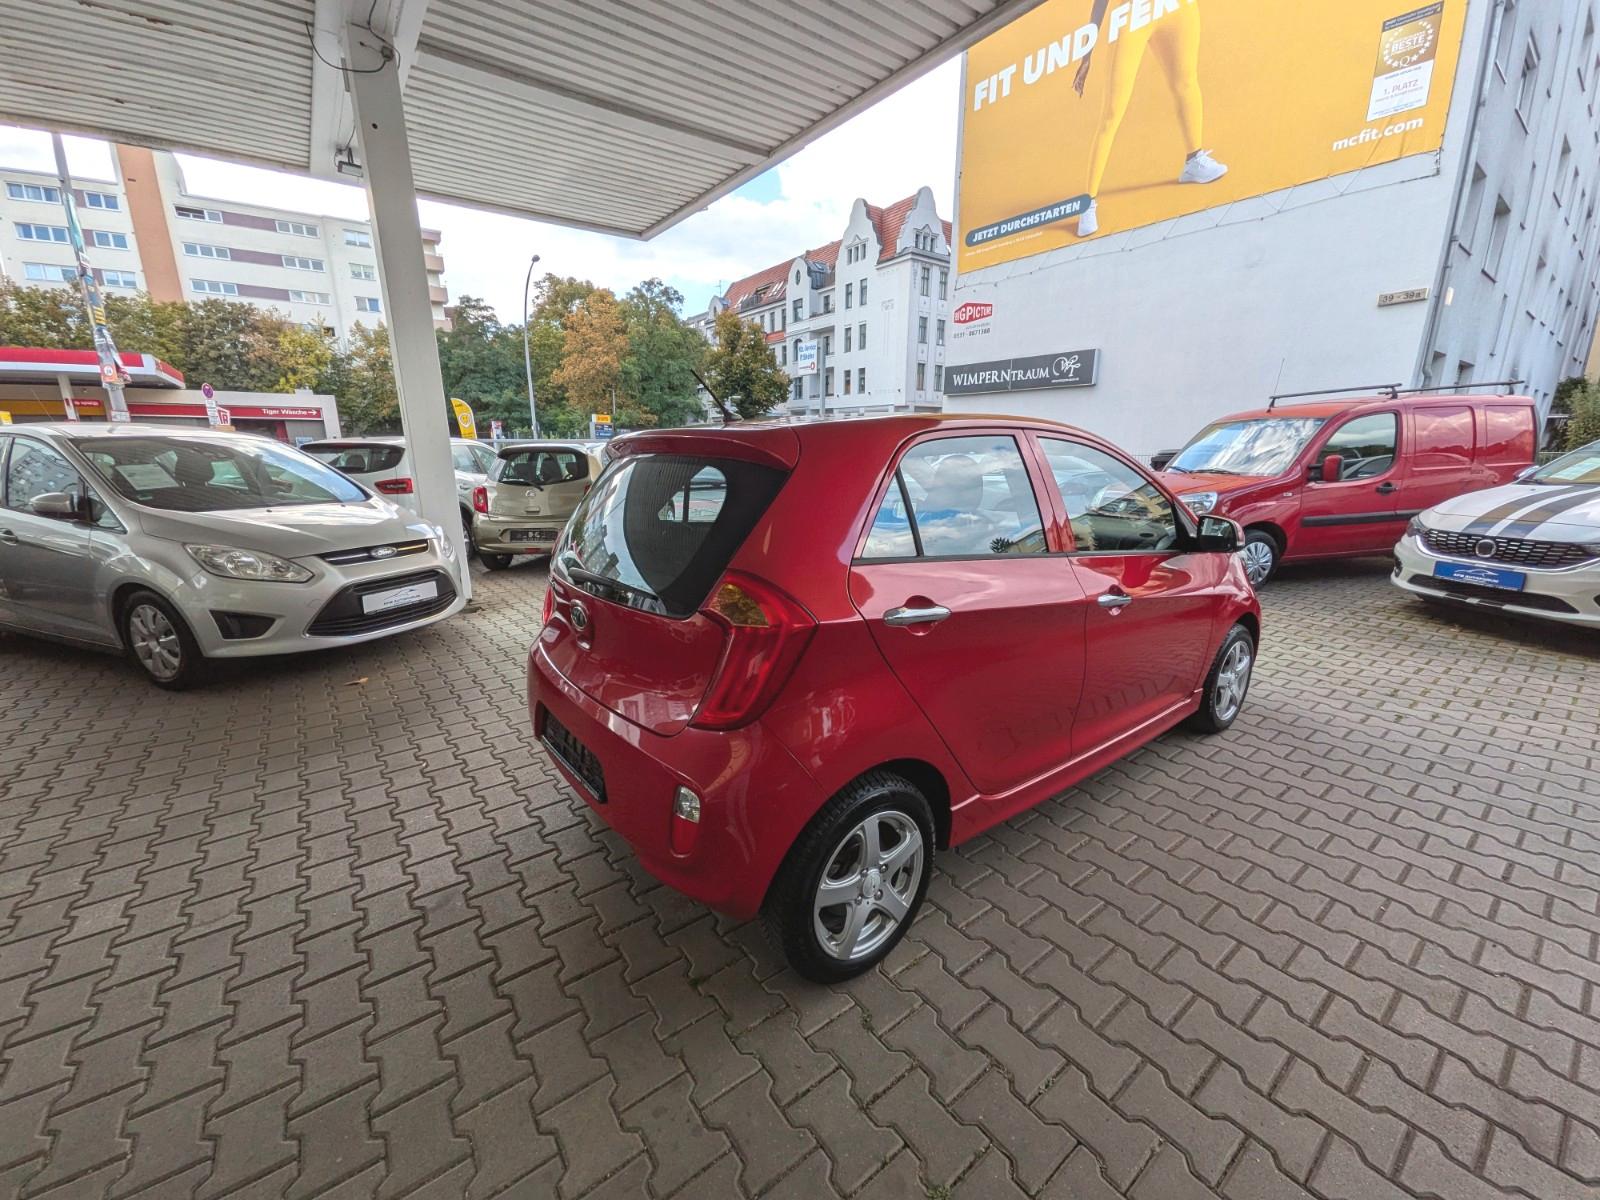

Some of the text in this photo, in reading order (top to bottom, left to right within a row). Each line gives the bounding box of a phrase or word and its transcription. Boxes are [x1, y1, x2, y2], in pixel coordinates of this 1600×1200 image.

[973, 0, 1194, 112] FIT UND FER
[1392, 79, 1419, 93] PLATZ
[1332, 118, 1424, 152] mcfit.com
[972, 200, 1081, 242] JETZT DURCHSTARTEN
[952, 366, 1050, 386] WIMPERNTRAUM
